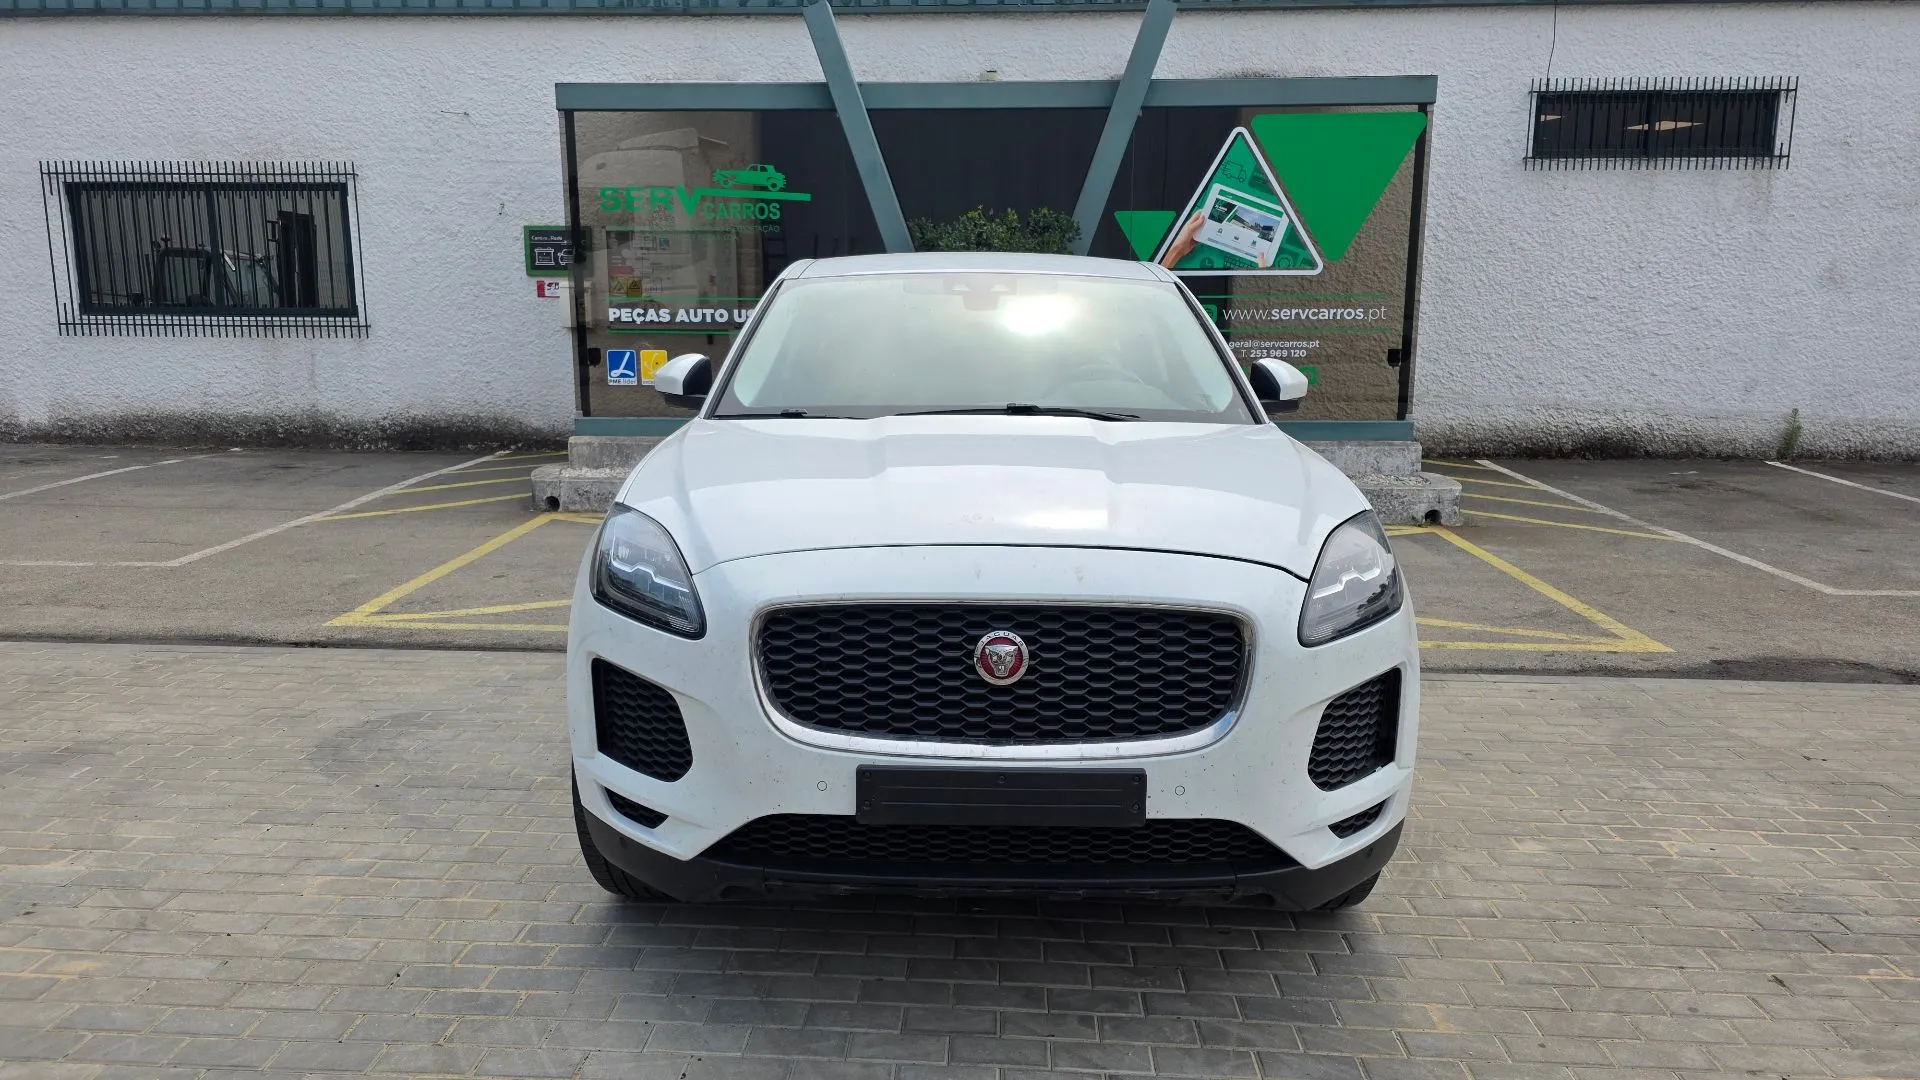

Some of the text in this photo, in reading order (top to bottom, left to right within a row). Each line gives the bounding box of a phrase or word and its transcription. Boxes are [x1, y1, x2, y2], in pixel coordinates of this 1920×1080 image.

[703, 202, 781, 220] CARROS
[608, 308, 671, 324] PEÇAS
[675, 308, 729, 323] AUTO
[1223, 306, 1387, 321] www.servcarros.pt
[1228, 340, 1320, 350] geral@servcarros.pt
[1241, 350, 1307, 358] T. 253 969 120
[981, 632, 1024, 646] JAGUAR
